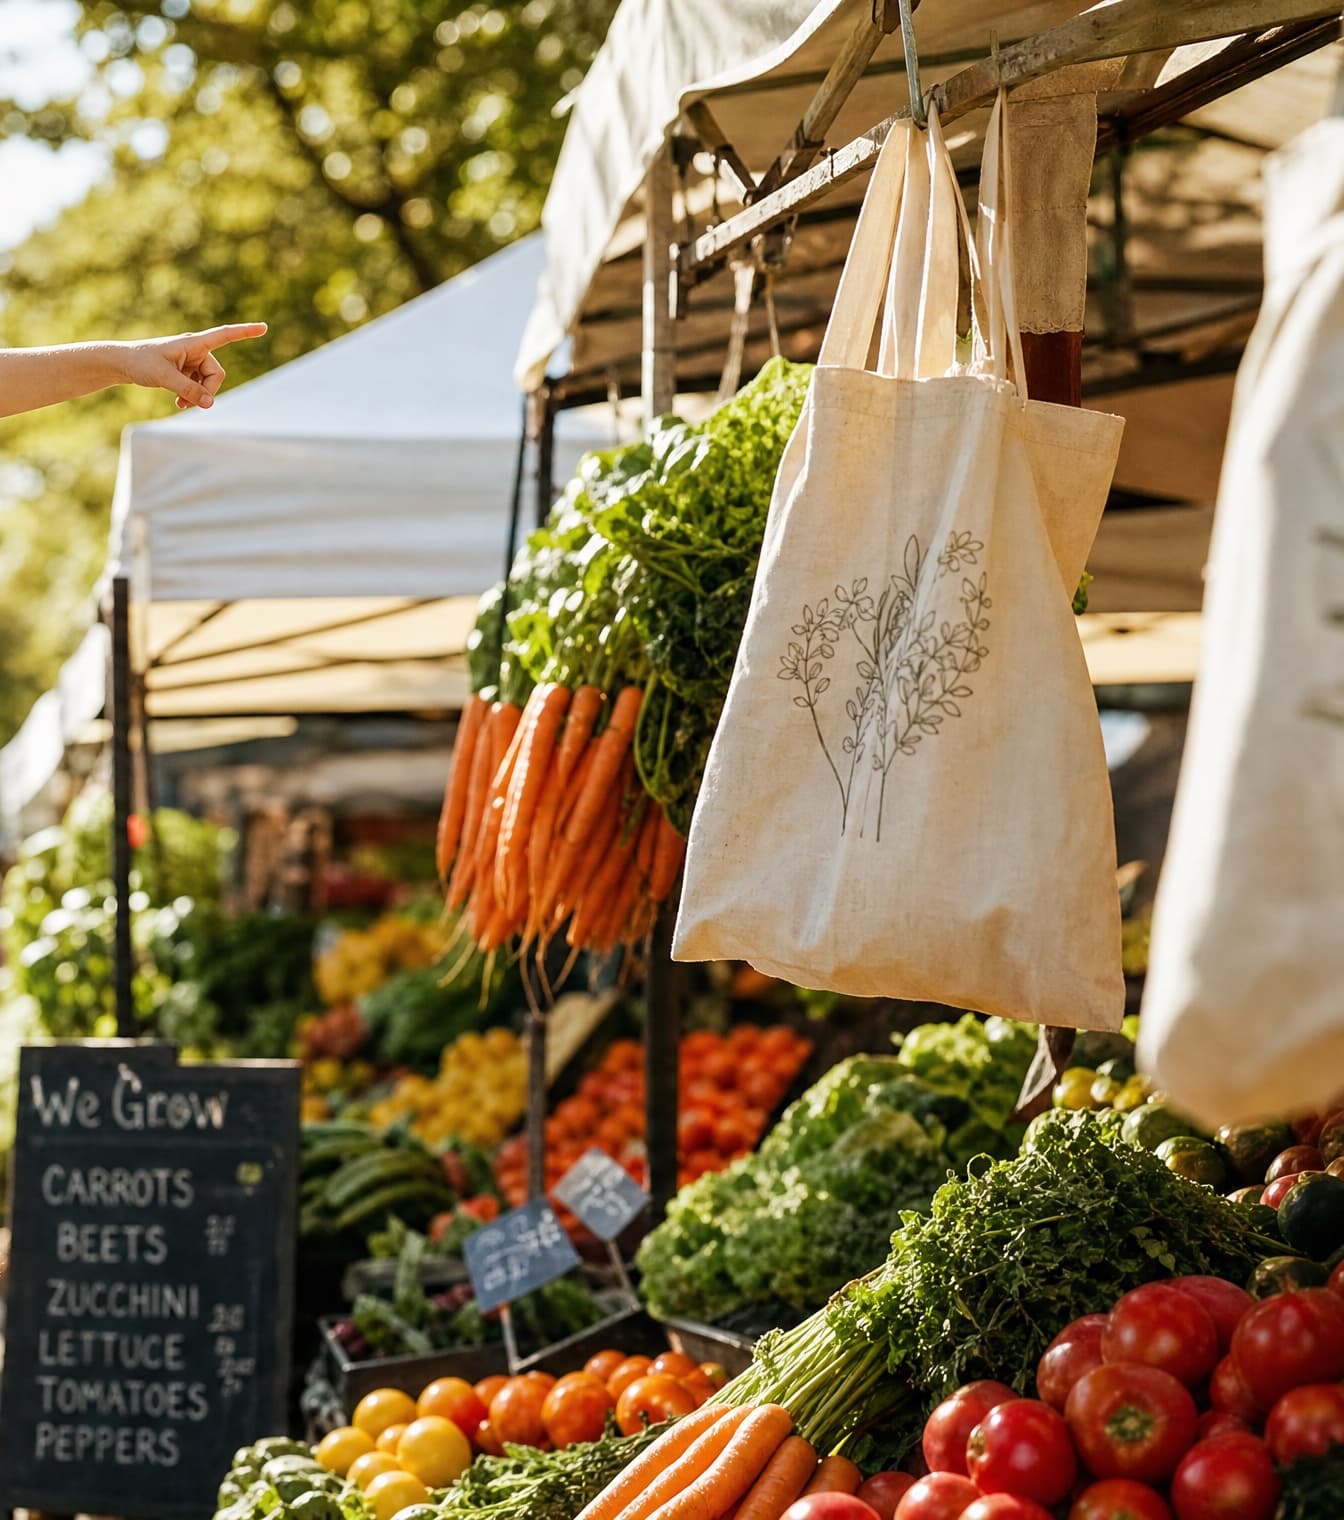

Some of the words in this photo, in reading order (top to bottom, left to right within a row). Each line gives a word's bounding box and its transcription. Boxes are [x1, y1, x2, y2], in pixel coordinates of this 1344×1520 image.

[31, 1076, 100, 1128] We
[113, 1063, 229, 1130] Grow
[42, 1164, 194, 1208] CARROTS
[57, 1223, 168, 1264] BEETS
[47, 1280, 199, 1319] ZUCCHINI
[39, 1333, 184, 1369] LETTUCE
[36, 1376, 208, 1420] TOMATOES
[36, 1424, 179, 1466] PEPPERS
